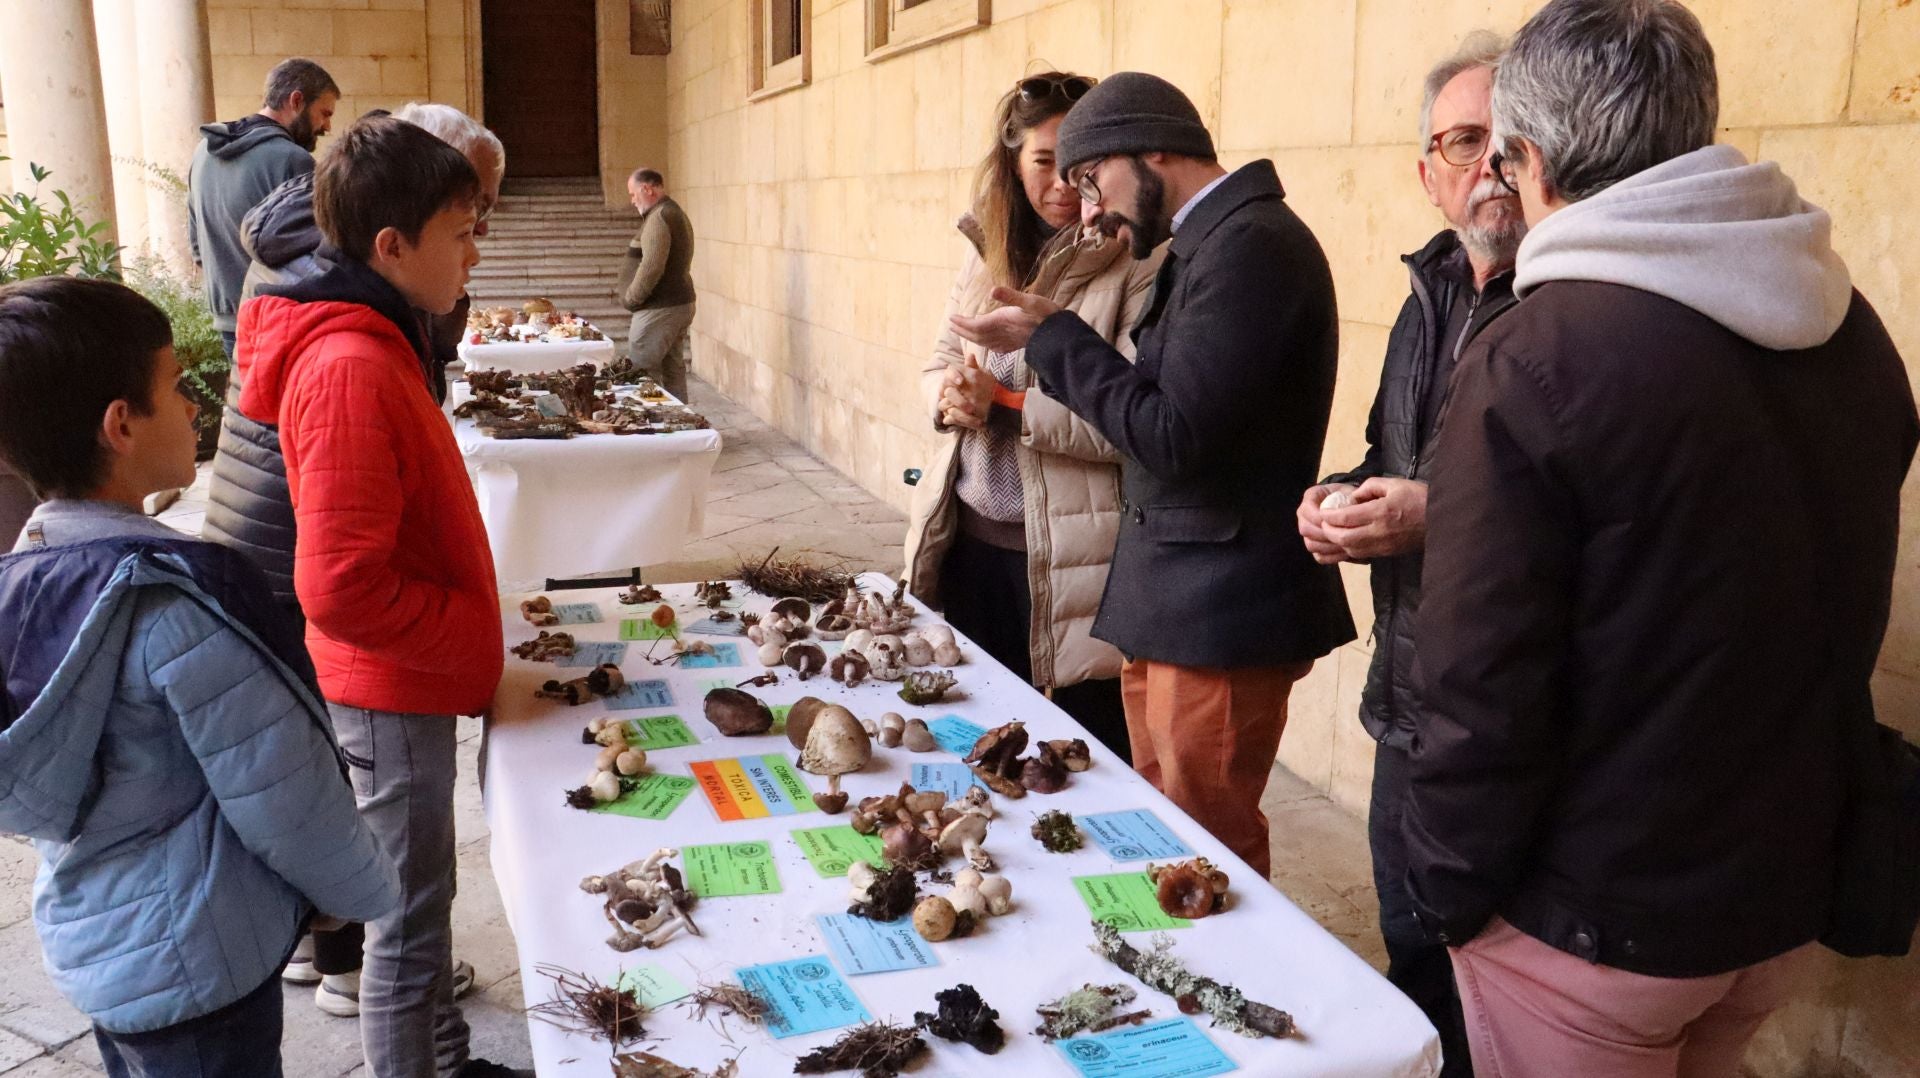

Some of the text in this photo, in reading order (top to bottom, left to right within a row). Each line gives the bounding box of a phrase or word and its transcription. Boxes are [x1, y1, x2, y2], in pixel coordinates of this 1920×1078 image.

[750, 767, 762, 778] SIN
[774, 765, 806, 800] COMESTIBLE
[703, 775, 728, 805] MORTAL
[729, 774, 752, 802] TOXICA
[898, 929, 927, 965] Lycoperdon
[1142, 1034, 1188, 1048] erinaceus
